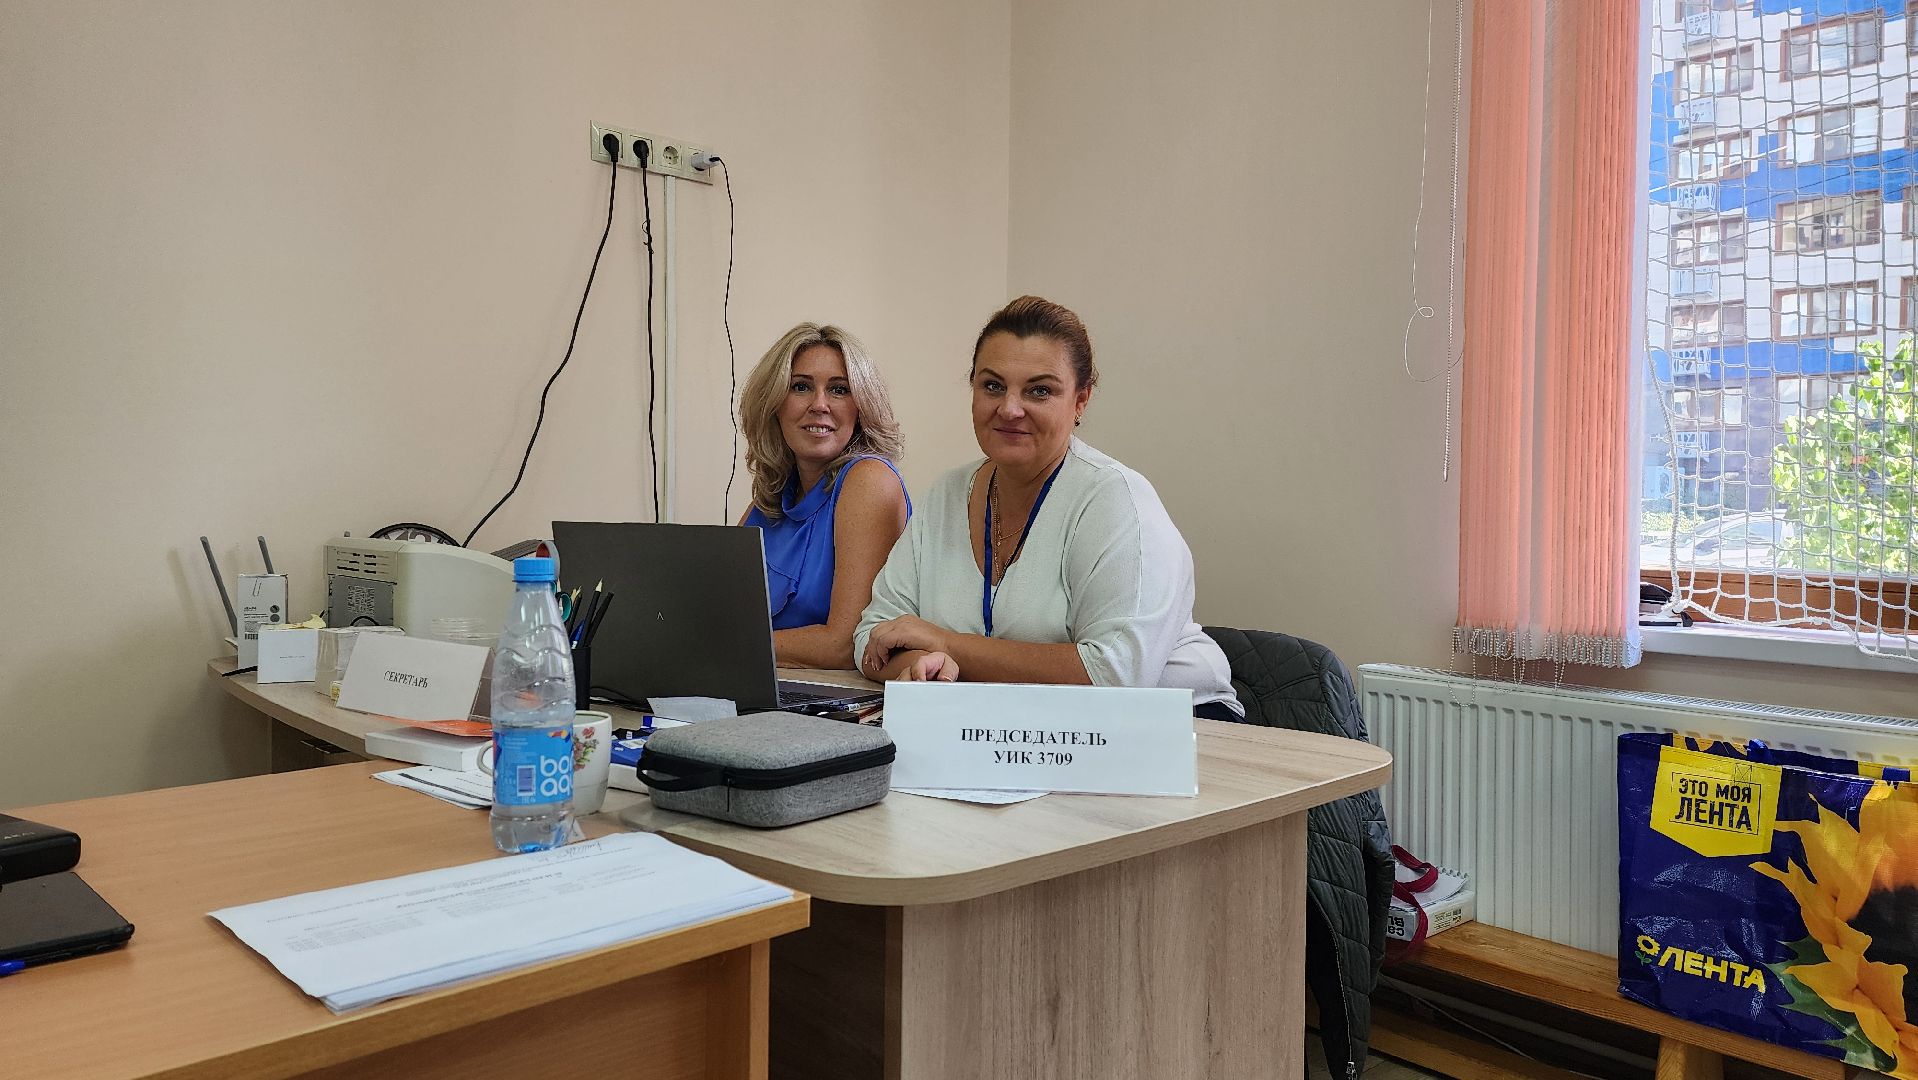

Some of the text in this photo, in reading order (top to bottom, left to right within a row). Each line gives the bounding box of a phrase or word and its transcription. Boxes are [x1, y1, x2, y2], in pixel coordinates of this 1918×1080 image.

[383, 670, 428, 689] СЕКРЕТАРЬ
[961, 728, 1107, 747] ПРЕДСЕДАТЕЛЬ
[994, 750, 1073, 766] УИК 3709
[540, 774, 574, 797] aq
[1679, 777, 1752, 803] ЭТО МОЯ
[1674, 796, 1753, 831] ЛЕНТА
[1657, 945, 1766, 994] ЛЕНТА
